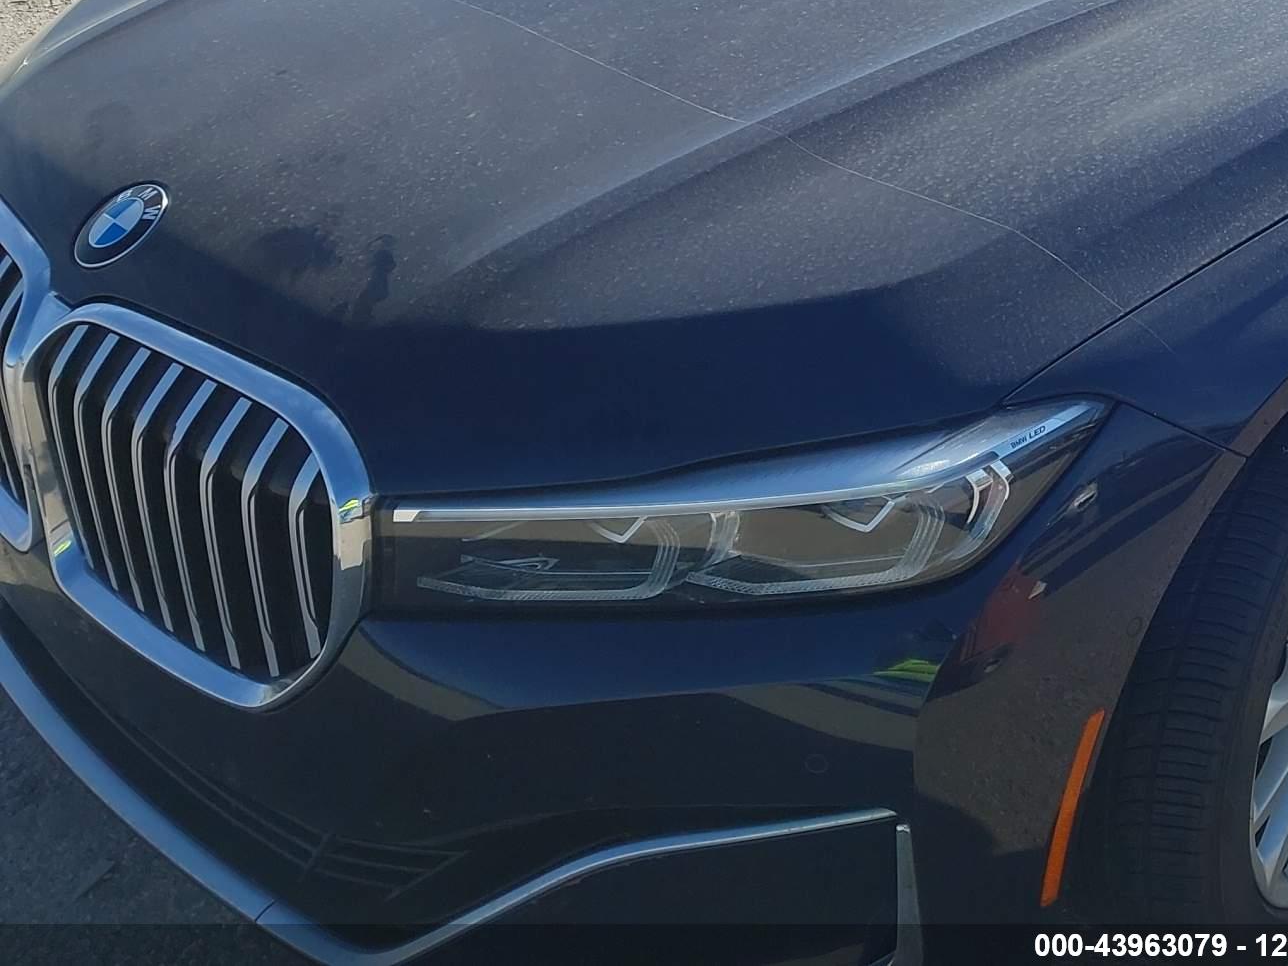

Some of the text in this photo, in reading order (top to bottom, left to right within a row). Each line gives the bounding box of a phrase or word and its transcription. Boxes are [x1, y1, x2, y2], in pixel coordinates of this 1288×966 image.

[116, 187, 161, 220] BMW
[1010, 425, 1046, 449] BMW LED
